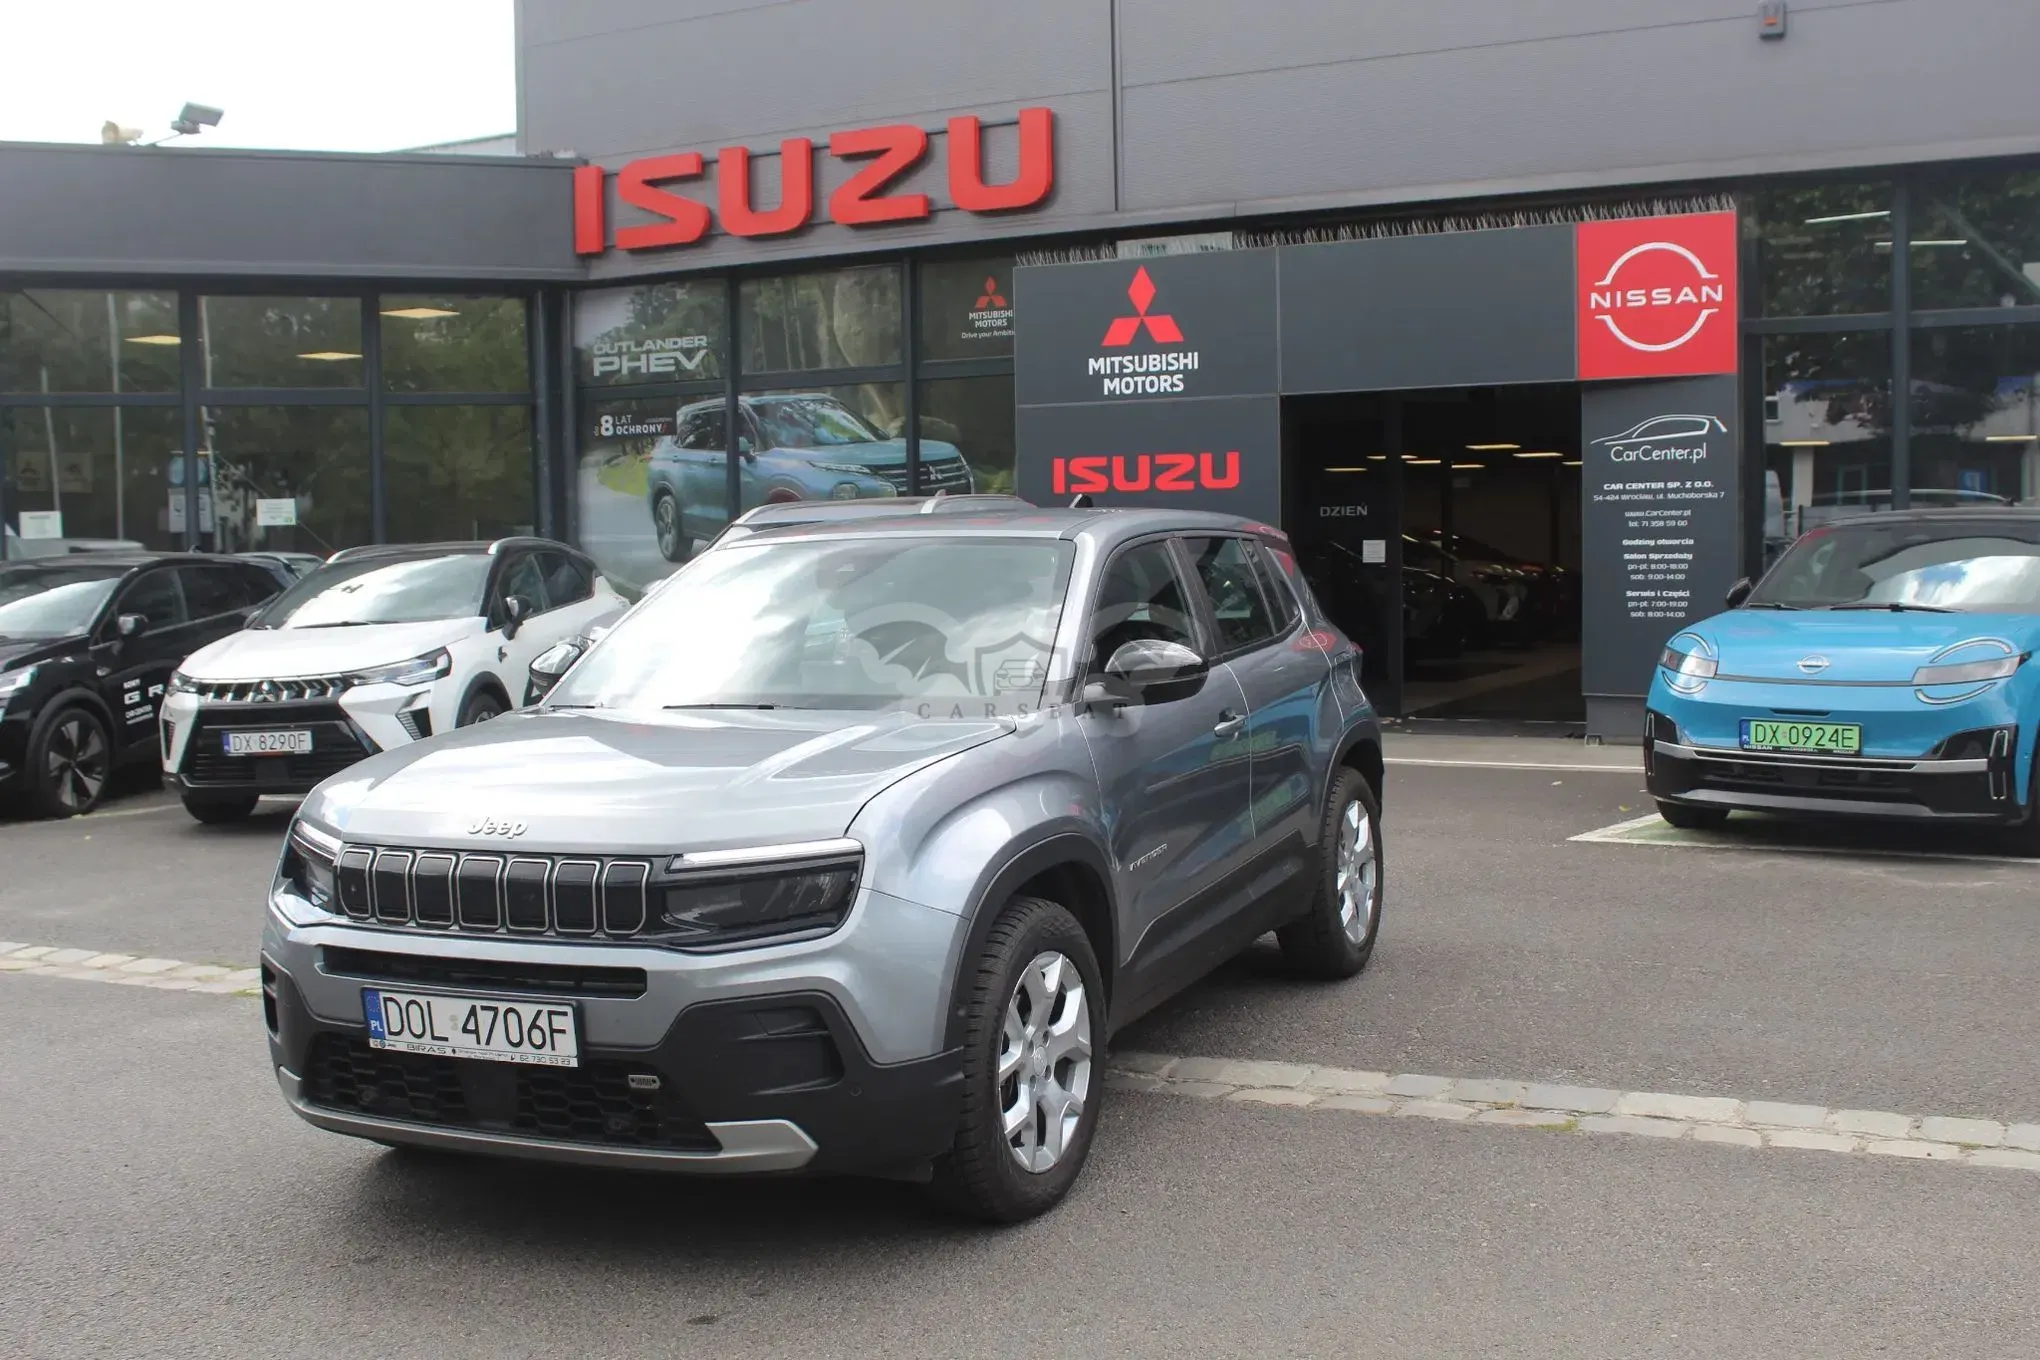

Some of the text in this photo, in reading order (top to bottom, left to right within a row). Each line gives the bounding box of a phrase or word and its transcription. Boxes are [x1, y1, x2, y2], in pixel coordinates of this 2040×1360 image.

[575, 107, 1053, 254] ISUZU
[1590, 284, 1723, 309] NISSAN
[968, 309, 1013, 320] MITSUBISHI
[974, 319, 1008, 328] MOTORS
[594, 335, 708, 354] OUTLANDER
[978, 331, 992, 339] your
[593, 350, 708, 377] PHEV
[1088, 352, 1199, 375] MITSUBISHI
[1103, 374, 1184, 395] MOTORS
[600, 415, 614, 436] 8
[616, 415, 632, 424] LAT
[616, 424, 662, 435] OCHRONY
[1610, 442, 1707, 463] CarCenter.pl
[1053, 451, 1240, 494] ISUZU
[1603, 482, 1624, 490] CAR
[1625, 481, 1665, 490] CENTER
[232, 735, 252, 751] DX
[258, 733, 306, 750] 8290F
[1754, 724, 1854, 748] DX 0924E
[467, 816, 529, 840] Jeep
[371, 1020, 383, 1032] PL
[382, 997, 569, 1051] DOL 4706F
